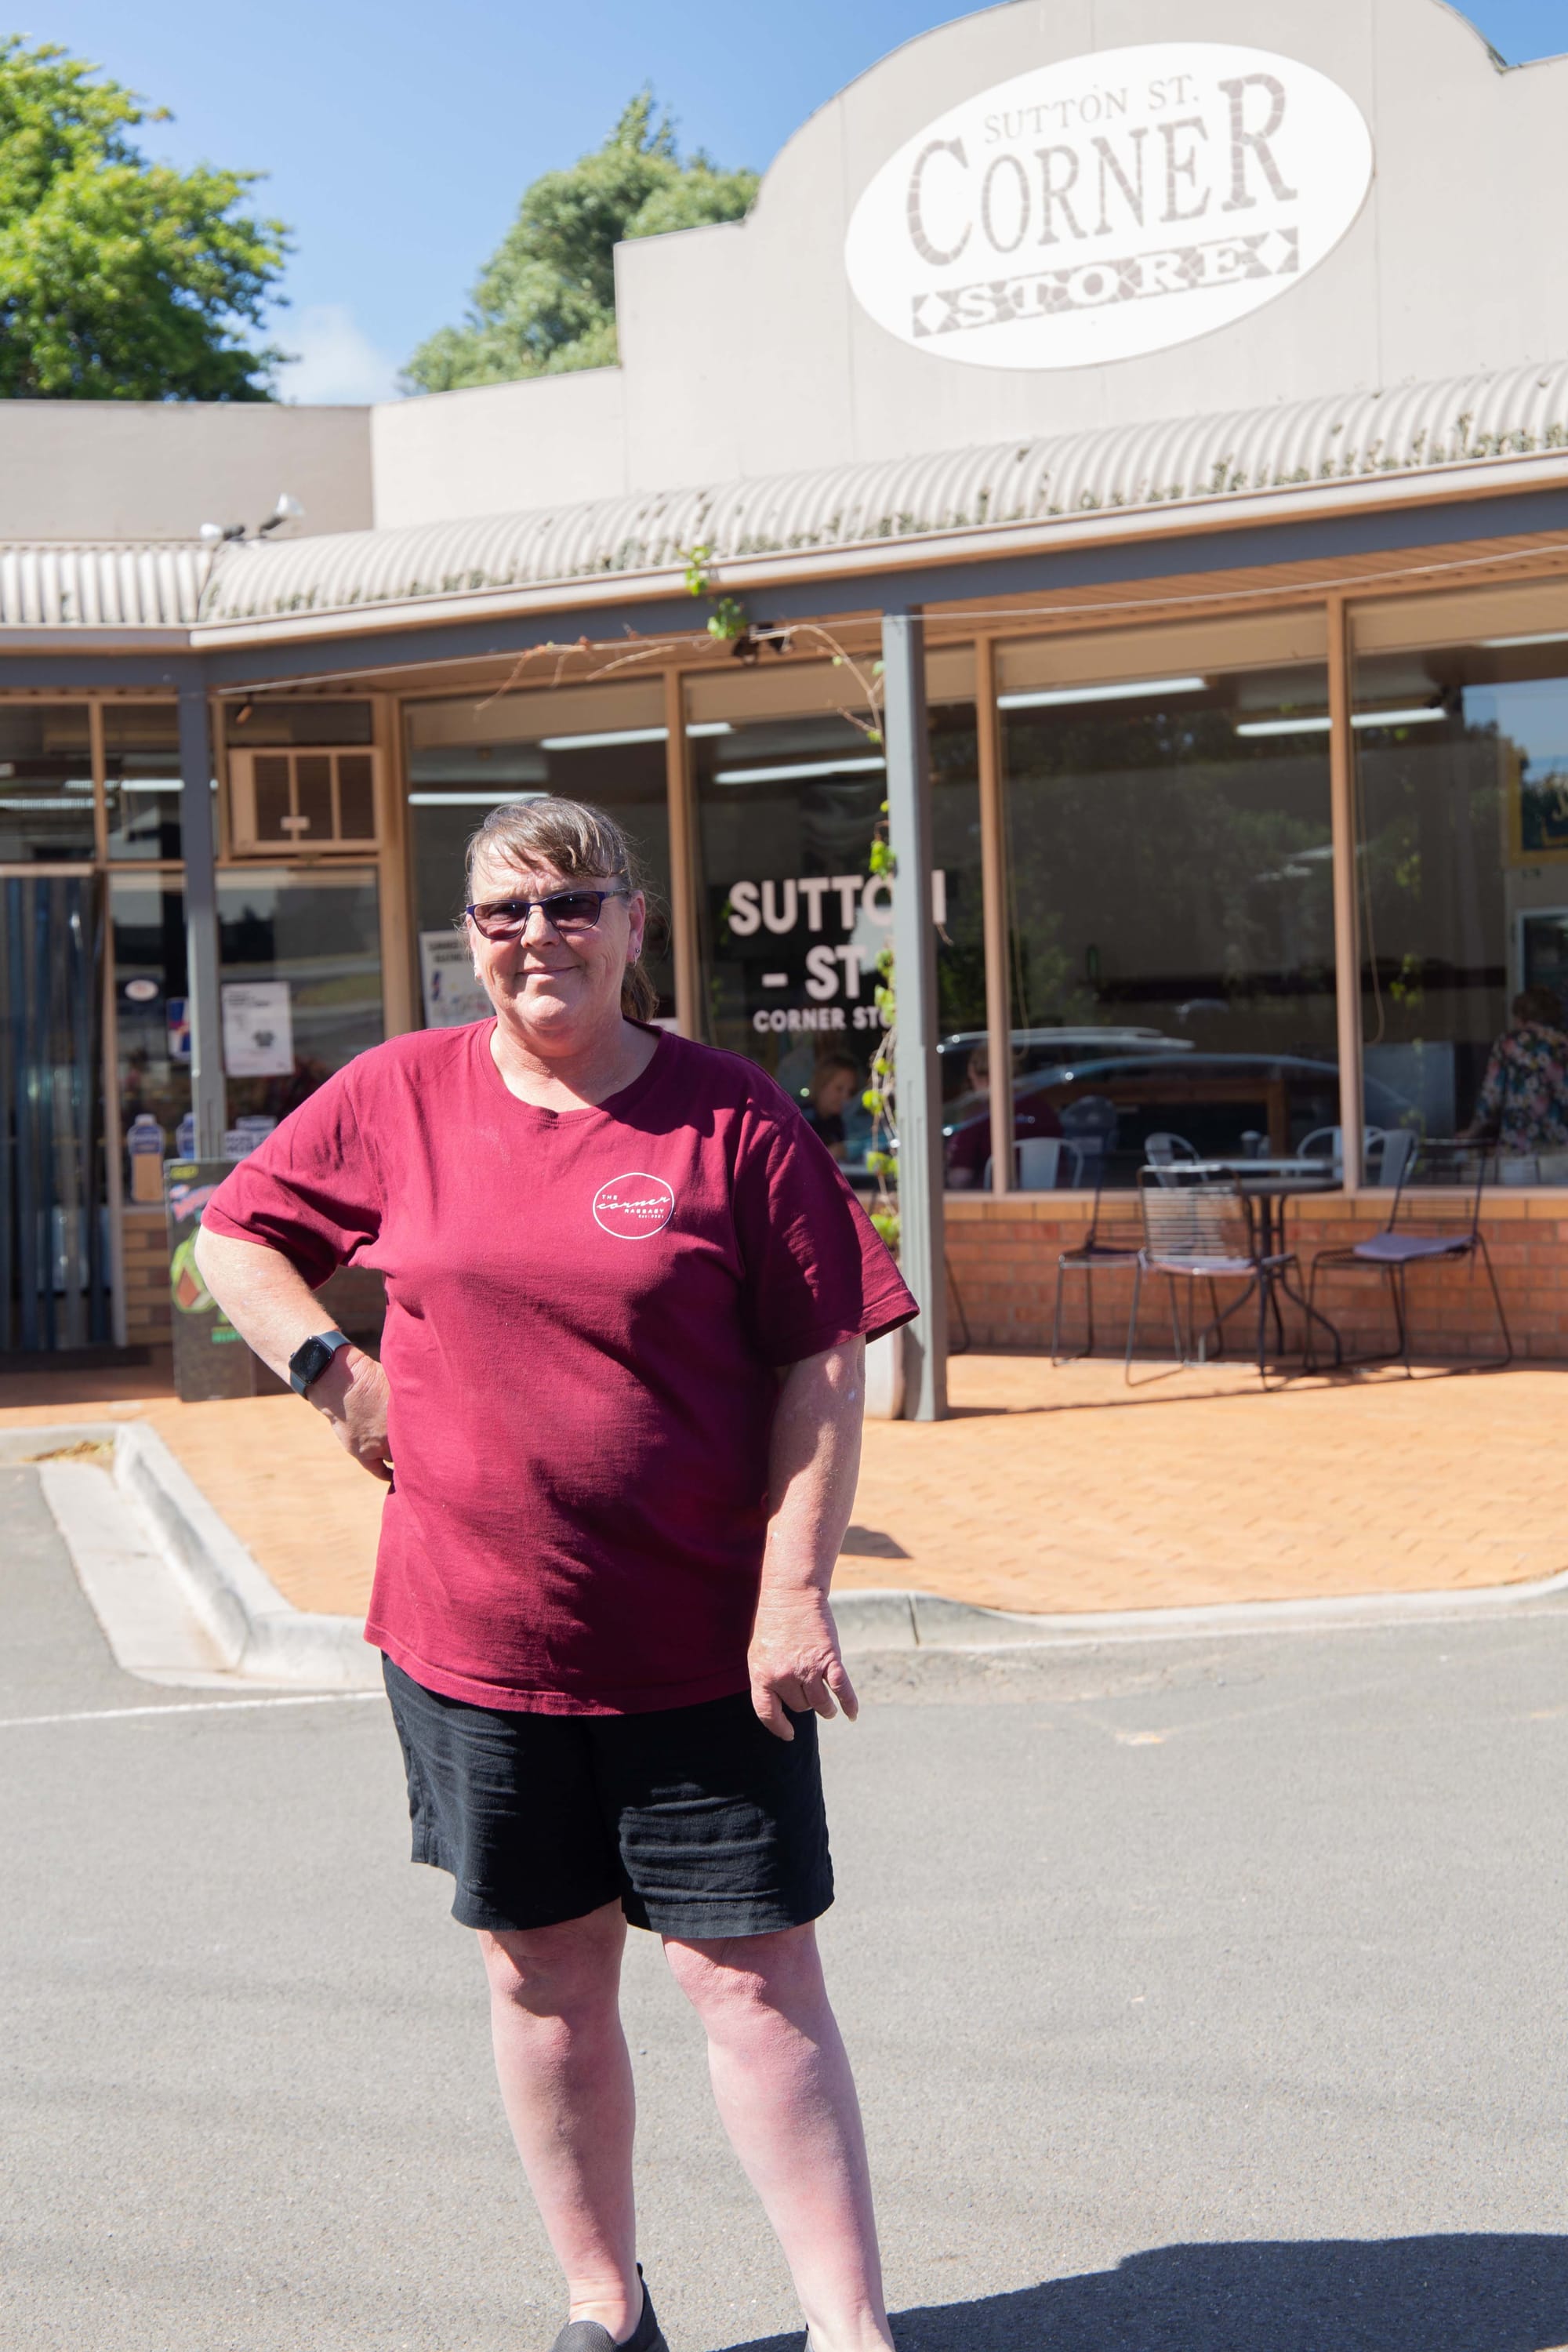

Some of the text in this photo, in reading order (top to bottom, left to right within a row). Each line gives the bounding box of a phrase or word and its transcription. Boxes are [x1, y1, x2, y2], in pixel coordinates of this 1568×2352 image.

[983, 74, 1200, 143] SUTTON ST.
[956, 238, 1249, 326] STORE
[753, 1007, 847, 1033] CORNER
